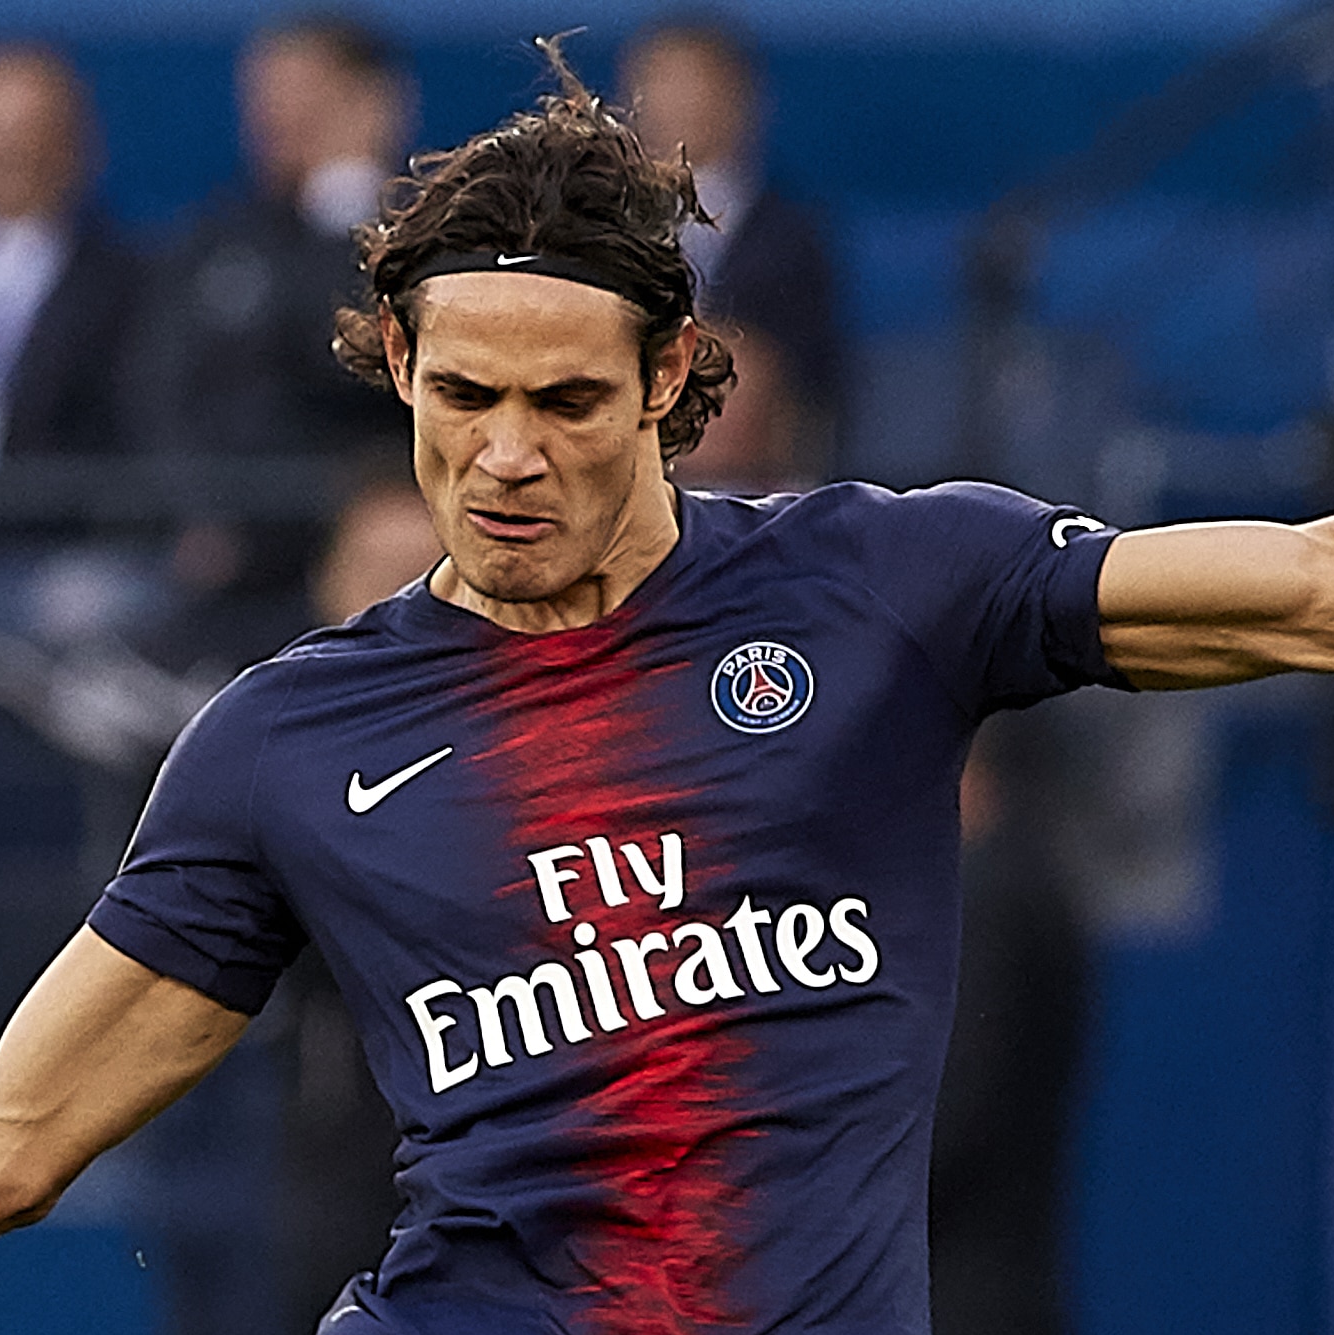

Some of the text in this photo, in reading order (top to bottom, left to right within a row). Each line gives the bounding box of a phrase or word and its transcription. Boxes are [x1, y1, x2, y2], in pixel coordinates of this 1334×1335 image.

[722, 646, 787, 677] PARIS
[527, 832, 684, 923] Fly
[406, 894, 879, 1093] Emirates
